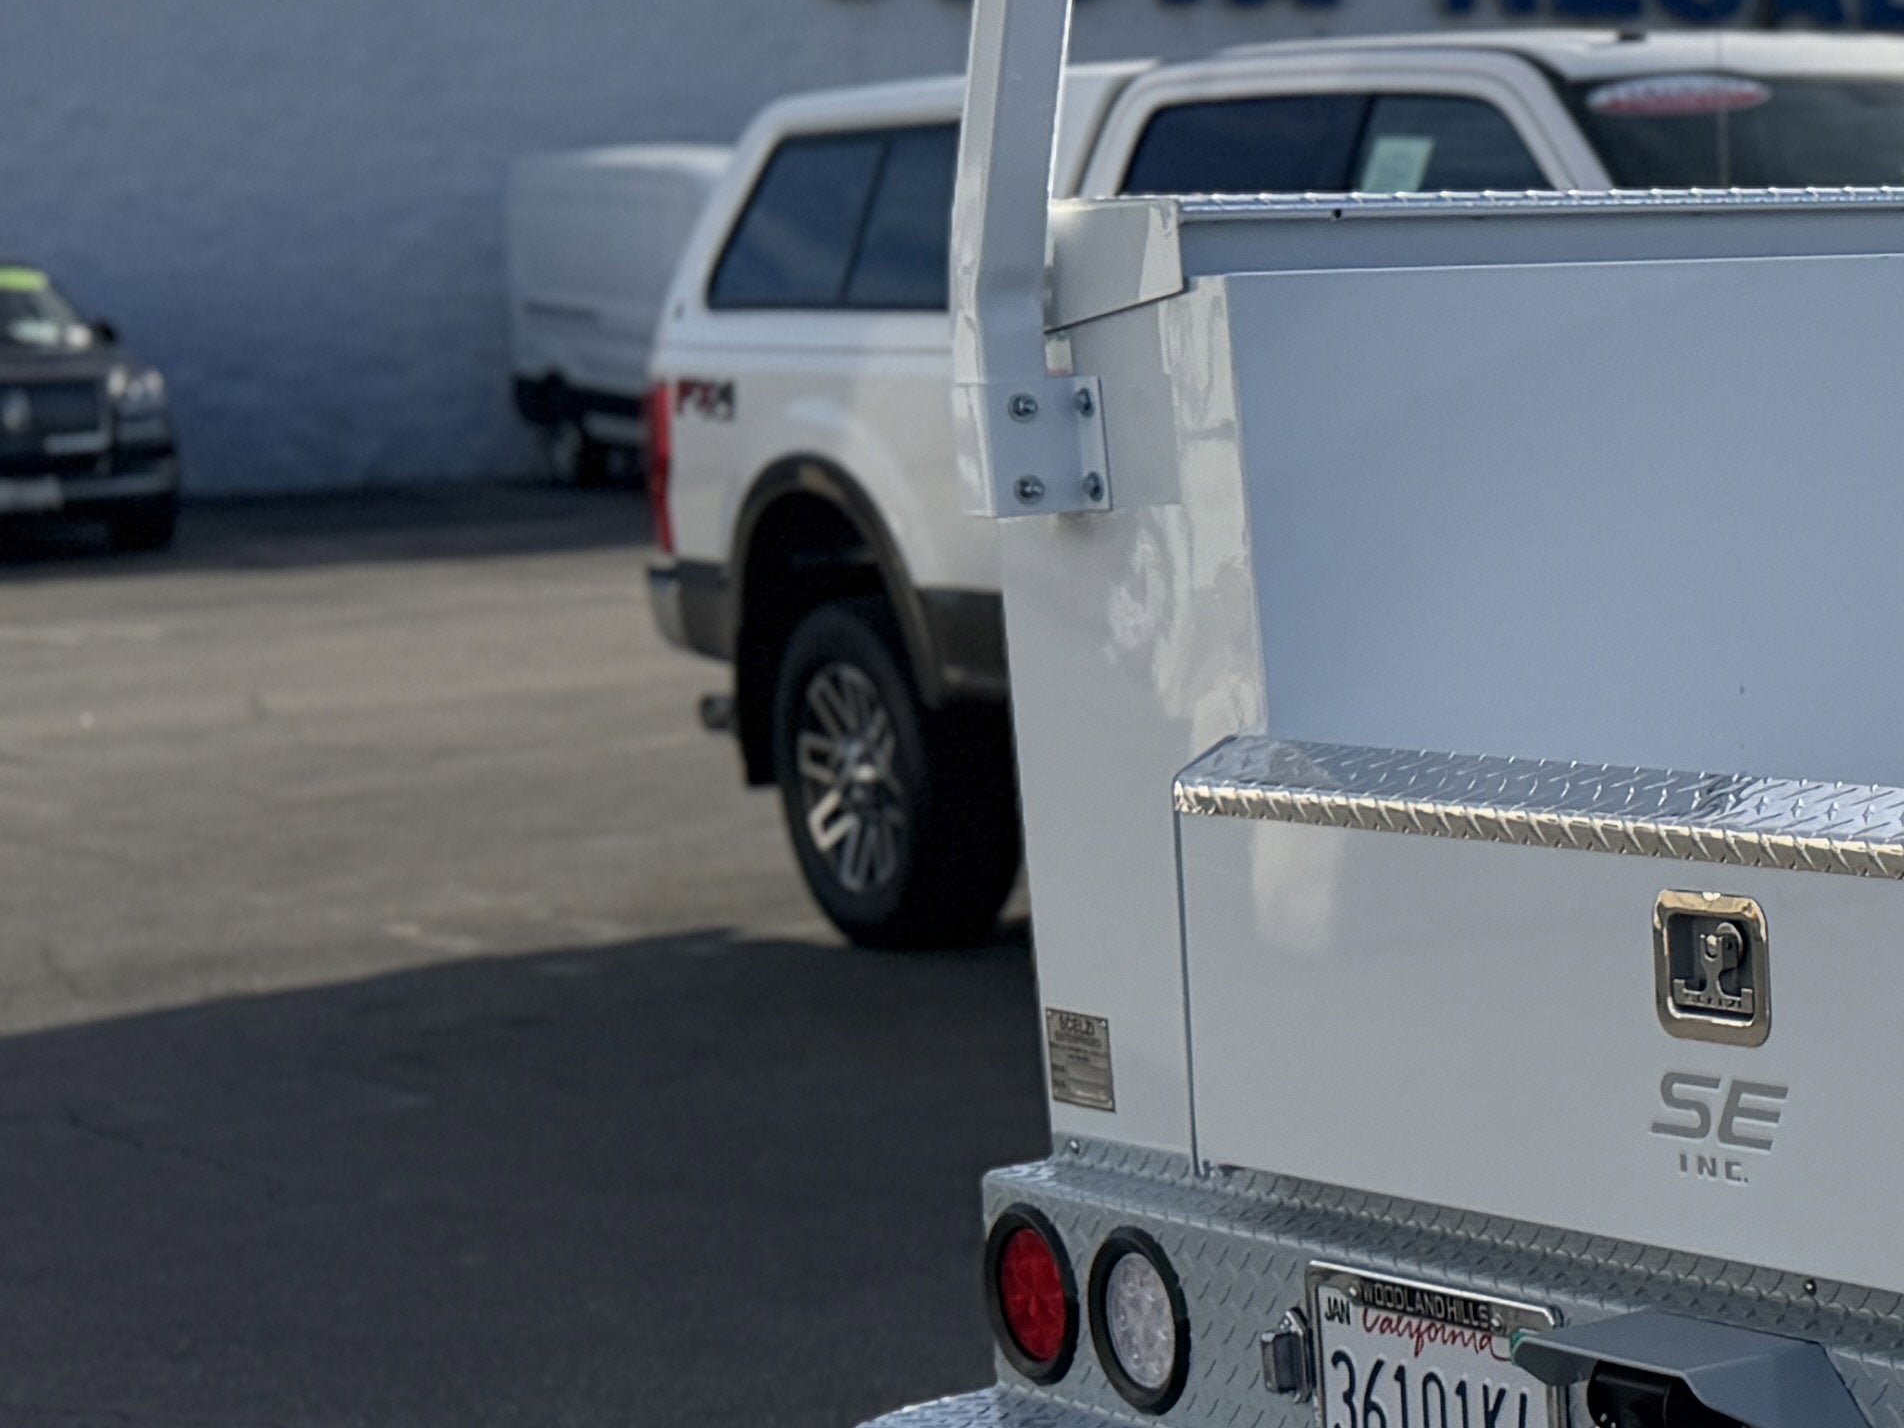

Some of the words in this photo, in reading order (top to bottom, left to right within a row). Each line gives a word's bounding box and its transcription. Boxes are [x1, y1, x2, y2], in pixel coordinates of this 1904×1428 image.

[1650, 1071, 1790, 1150] SE
[1679, 1152, 1749, 1184] INC.
[1325, 1295, 1351, 1325] JAN
[1361, 1281, 1445, 1319] WOODLAND
[1446, 1298, 1490, 1329] HILLS
[1361, 1307, 1512, 1360] California
